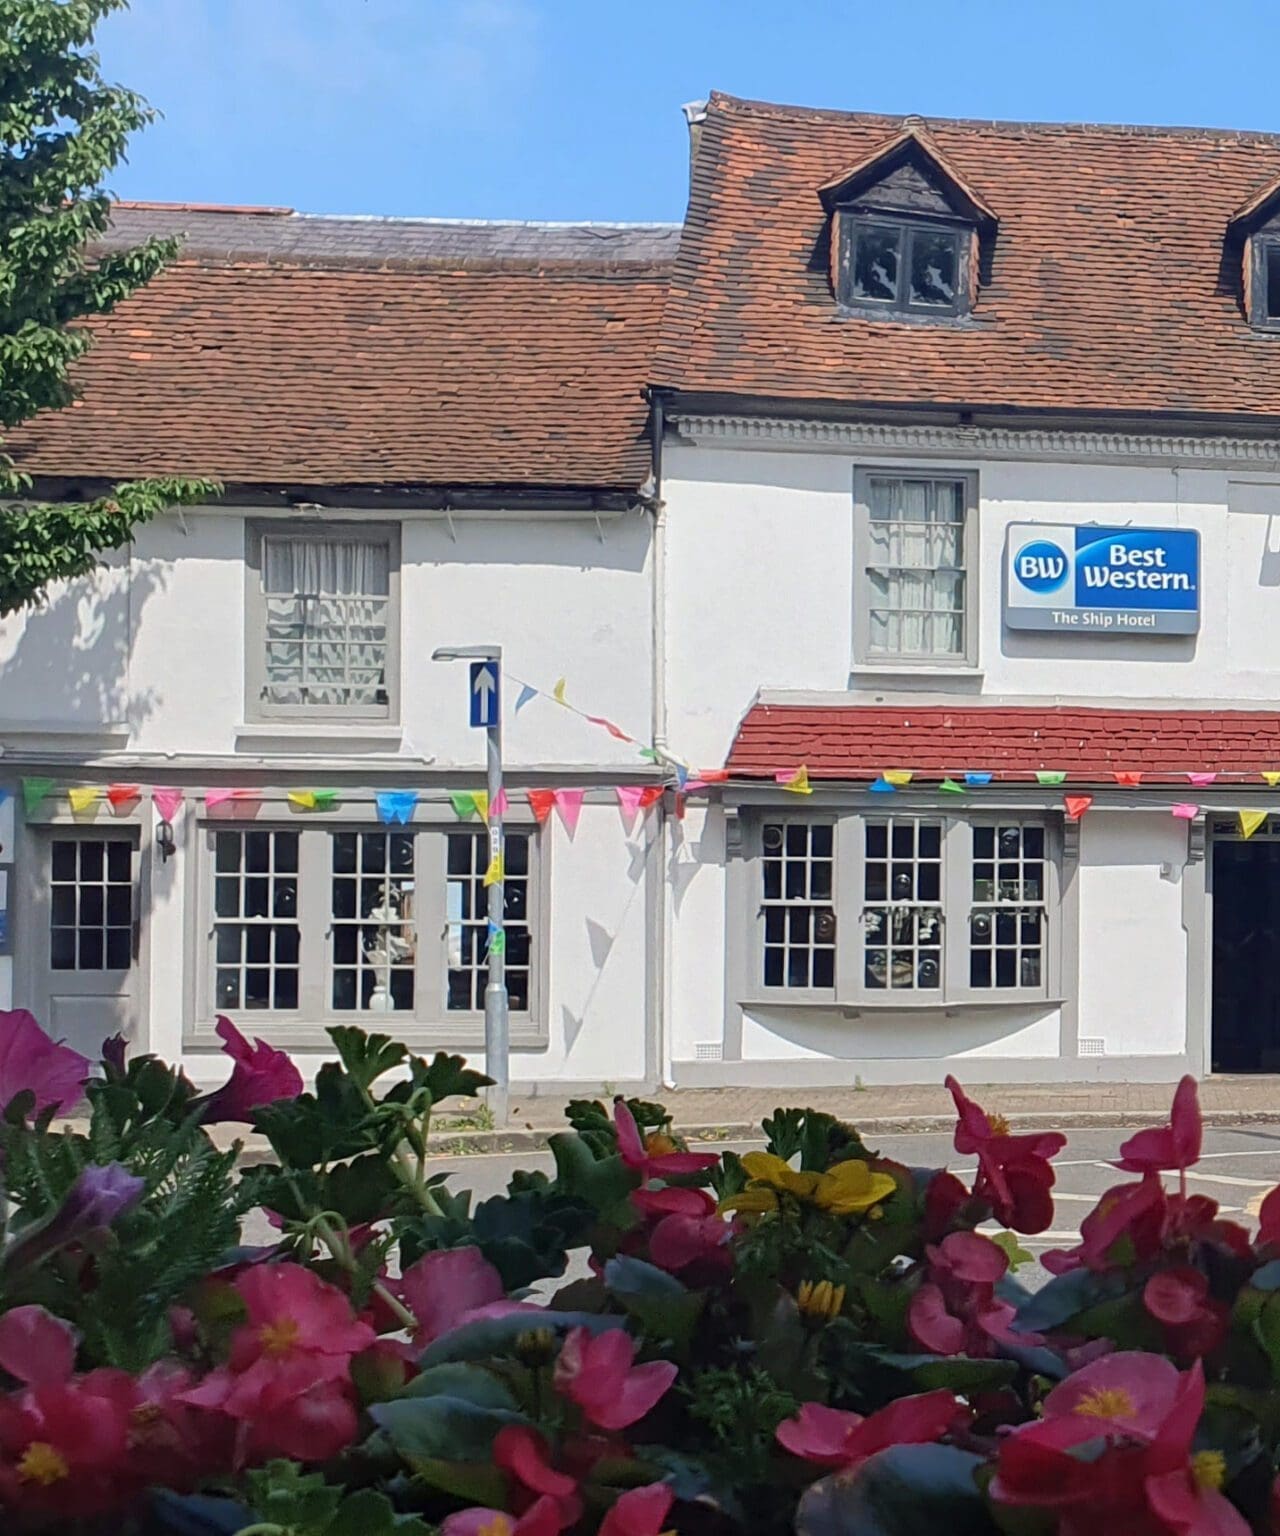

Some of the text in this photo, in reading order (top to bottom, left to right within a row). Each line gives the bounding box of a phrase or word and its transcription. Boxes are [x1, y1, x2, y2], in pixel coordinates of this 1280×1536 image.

[1020, 556, 1064, 579] BW
[1109, 544, 1167, 568] Best
[1051, 611, 1156, 628] The Ship Hotel
